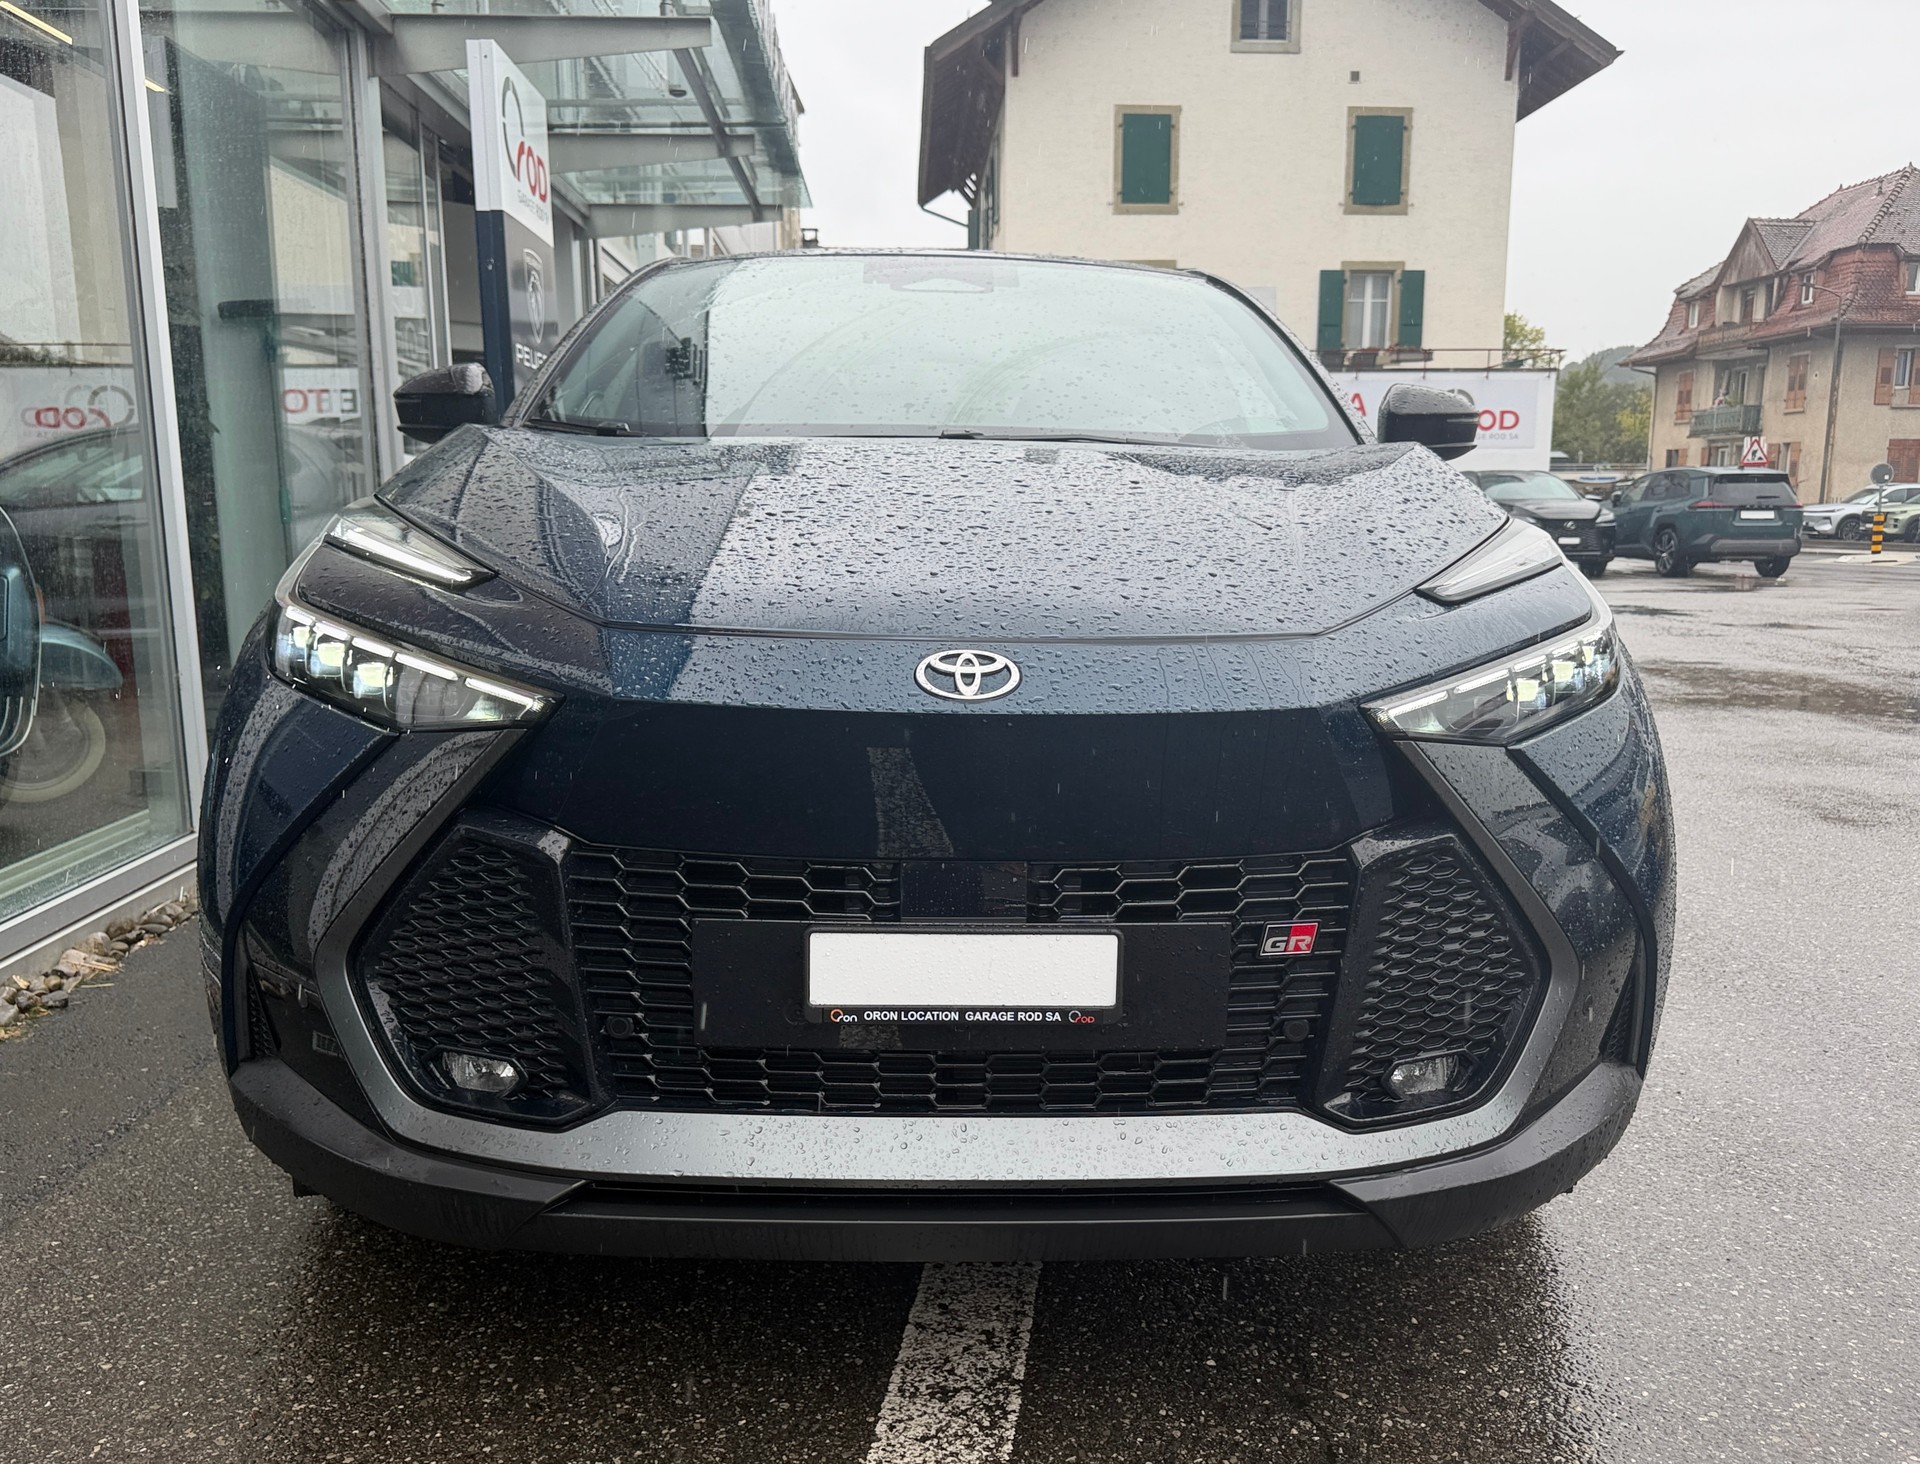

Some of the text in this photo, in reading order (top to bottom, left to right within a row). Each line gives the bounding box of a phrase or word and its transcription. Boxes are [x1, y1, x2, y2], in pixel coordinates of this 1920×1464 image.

[515, 343, 548, 369] PEUG
[1264, 935, 1312, 952] GR
[863, 1011, 898, 1021] ORON
[901, 1011, 959, 1021] LOCATION
[965, 1011, 1015, 1021] GARAGE
[1018, 1011, 1043, 1021] ROD
[1045, 1011, 1062, 1021] SA
